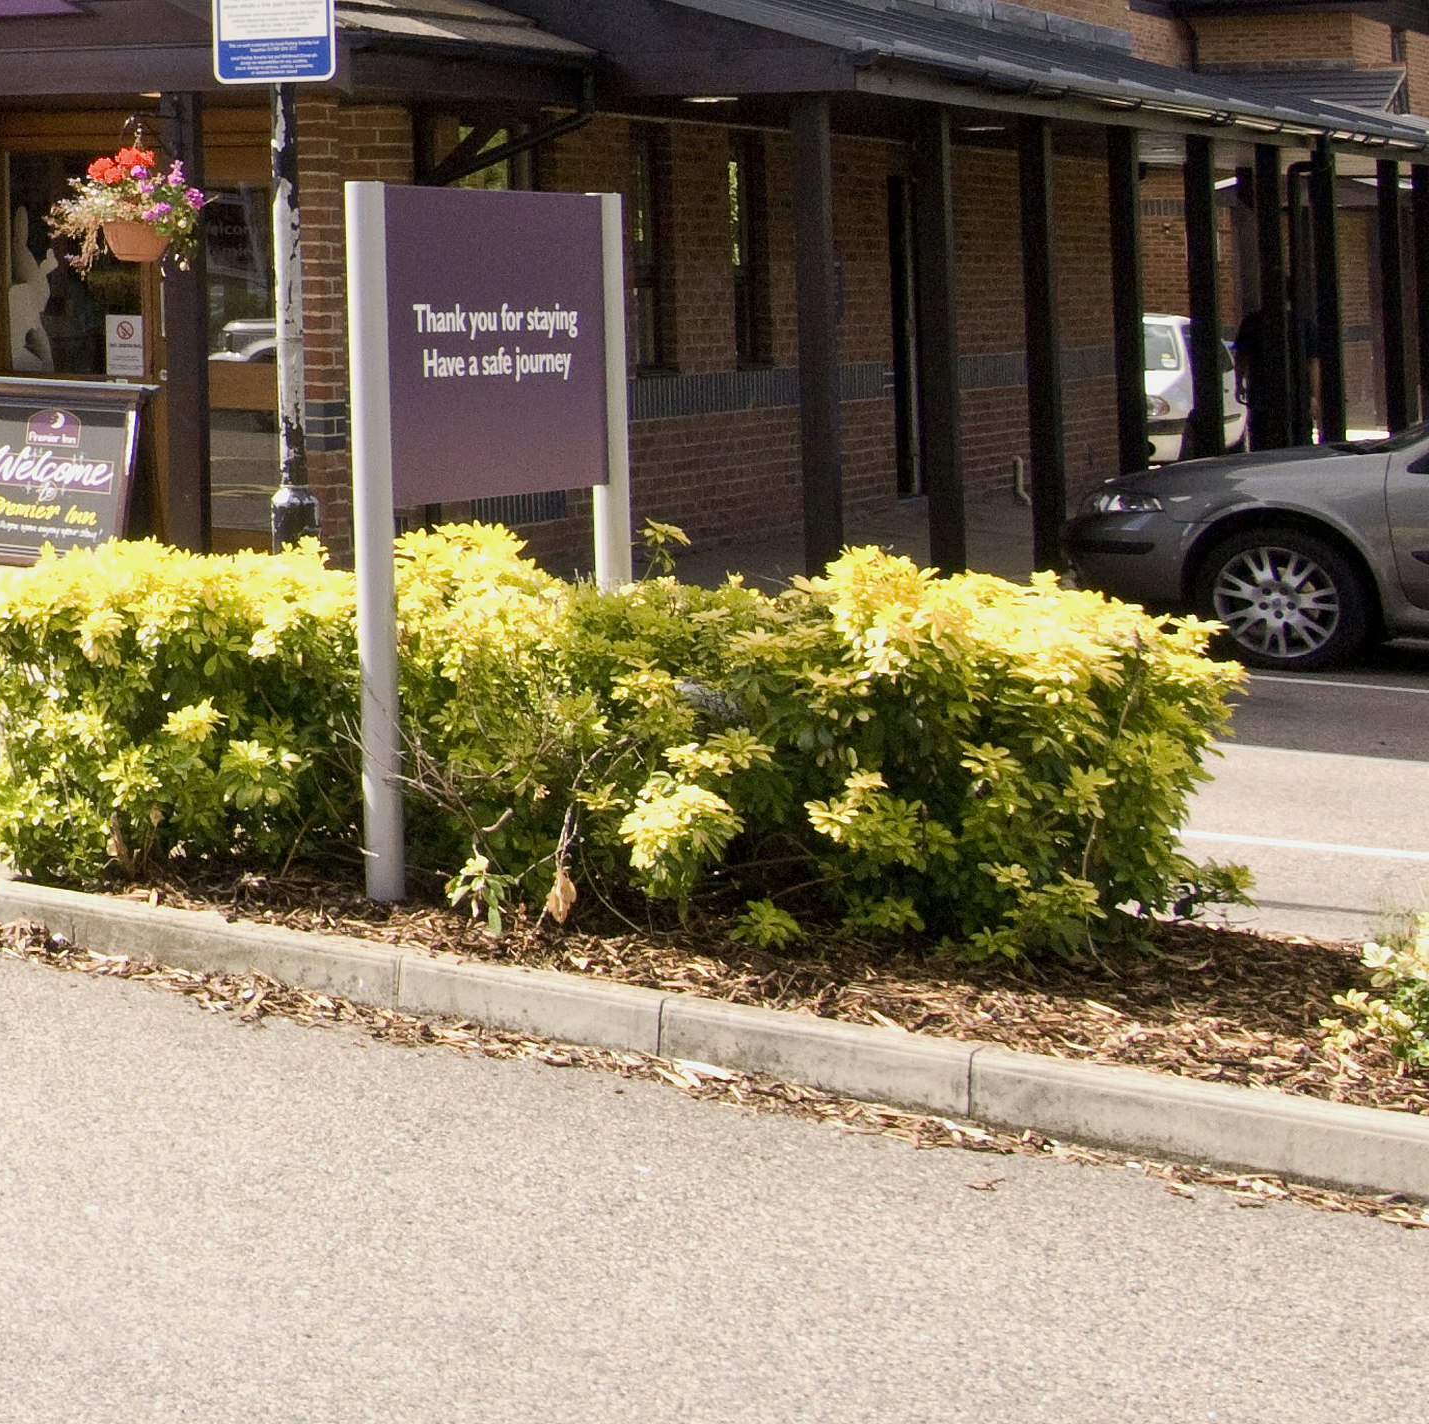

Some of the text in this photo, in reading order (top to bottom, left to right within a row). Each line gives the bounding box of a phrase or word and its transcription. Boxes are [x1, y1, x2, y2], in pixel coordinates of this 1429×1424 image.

[413, 302, 579, 340] Thank you for staying
[423, 346, 572, 382] Have a safe journey
[29, 431, 77, 444] Premier Inn
[36, 481, 58, 502] to
[64, 504, 98, 526] Inn
